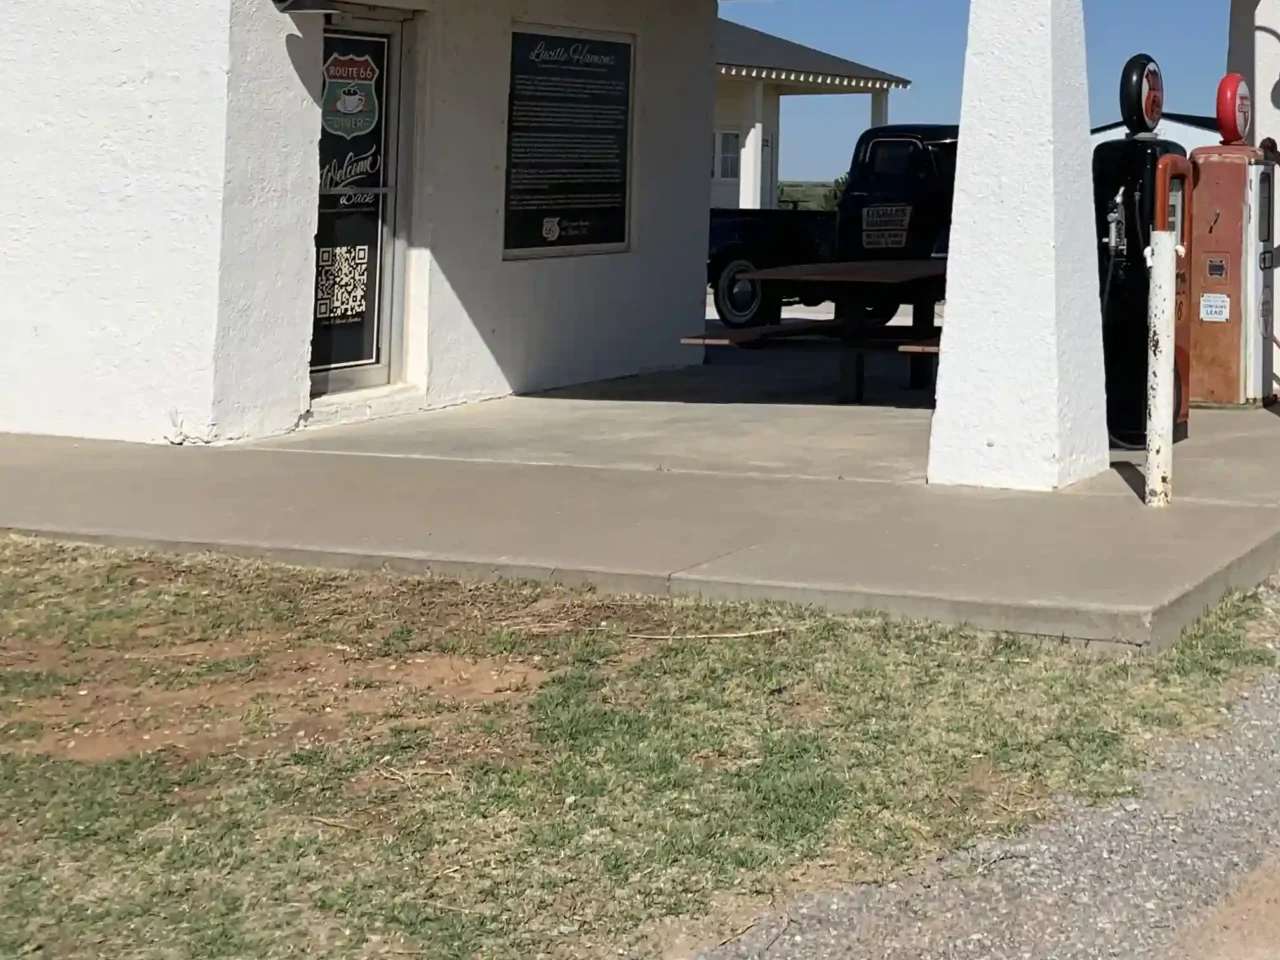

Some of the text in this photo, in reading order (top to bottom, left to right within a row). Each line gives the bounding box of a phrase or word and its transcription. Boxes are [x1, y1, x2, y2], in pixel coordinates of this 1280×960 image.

[529, 41, 569, 62] Lucille
[329, 66, 373, 79] ROUTE 66
[333, 117, 364, 129] DINER
[319, 144, 381, 190] Welcome
